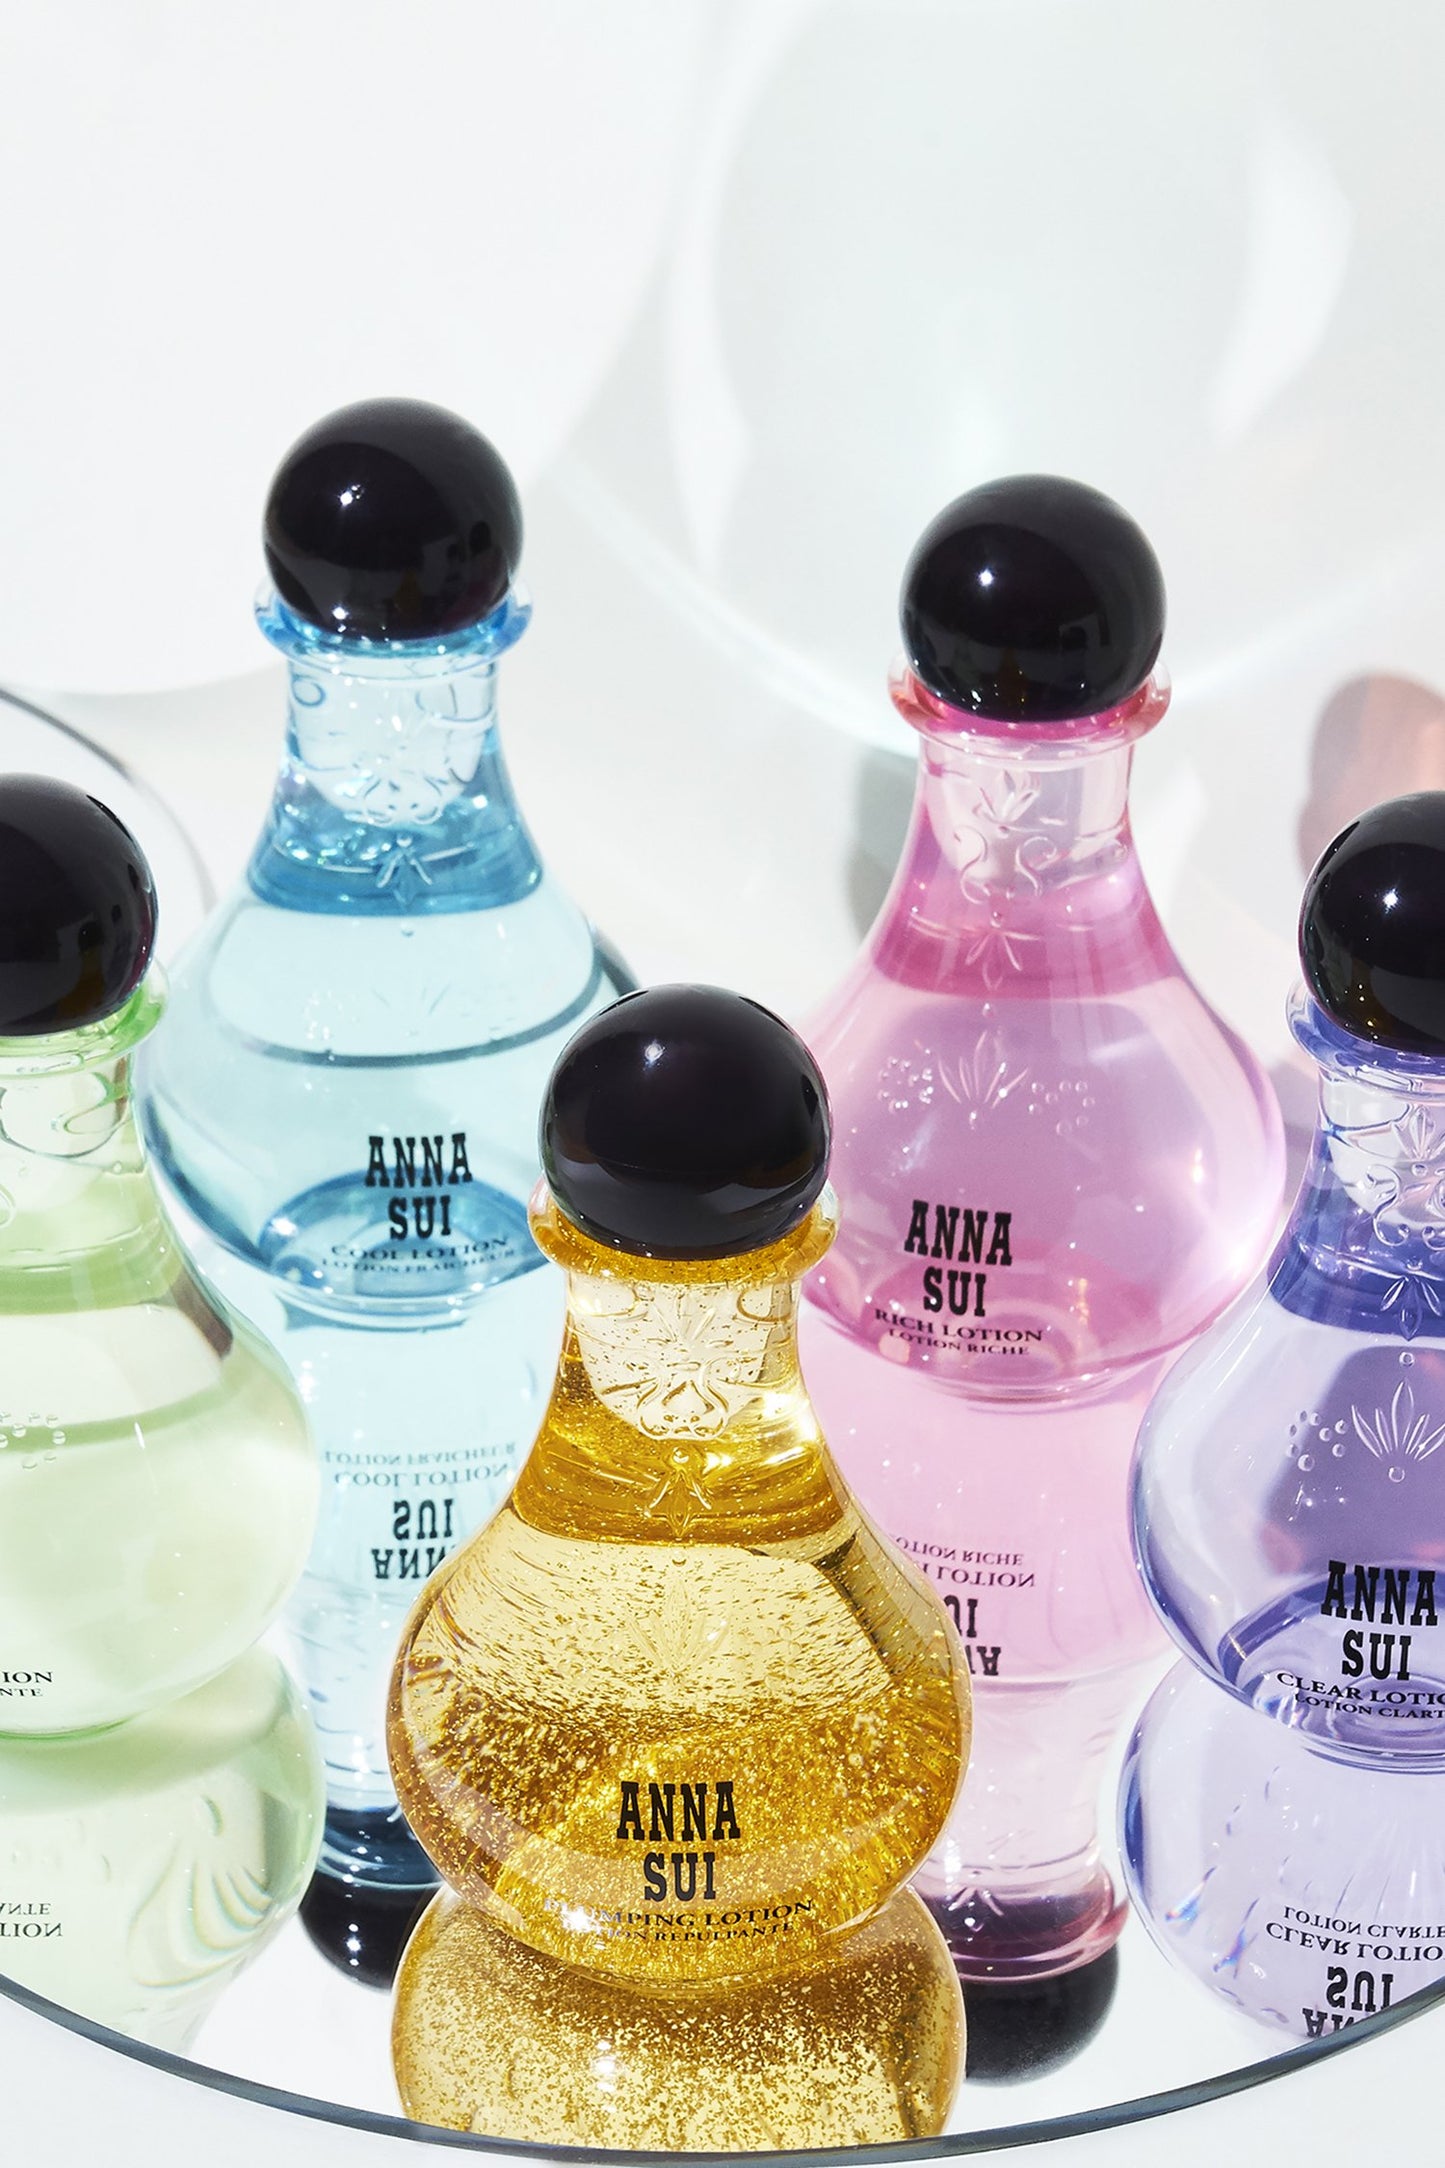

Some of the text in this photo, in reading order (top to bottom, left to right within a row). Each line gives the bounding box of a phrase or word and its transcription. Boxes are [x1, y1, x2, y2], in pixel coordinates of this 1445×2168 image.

[365, 1132, 473, 1188] ANNA
[388, 1195, 451, 1240] SUI
[904, 1199, 1012, 1266] ANNA
[331, 1236, 508, 1260] COOL LOTION
[923, 1266, 986, 1317] SUI
[874, 1308, 1043, 1342] RICH LOTION
[889, 1328, 1030, 1355] LOTION RICHE
[1321, 1560, 1438, 1626] ANNA
[1342, 1629, 1411, 1681] SUI
[2, 1671, 53, 1683] ION
[1277, 1672, 1363, 1700] CLEAR
[1295, 1693, 1445, 1718] LOTION CLART
[617, 1781, 740, 1841] ANNA
[644, 1852, 716, 1901] SUI
[543, 1898, 813, 1926] PUMPING LOTION
[655, 1921, 794, 1941] REPULPANTE
